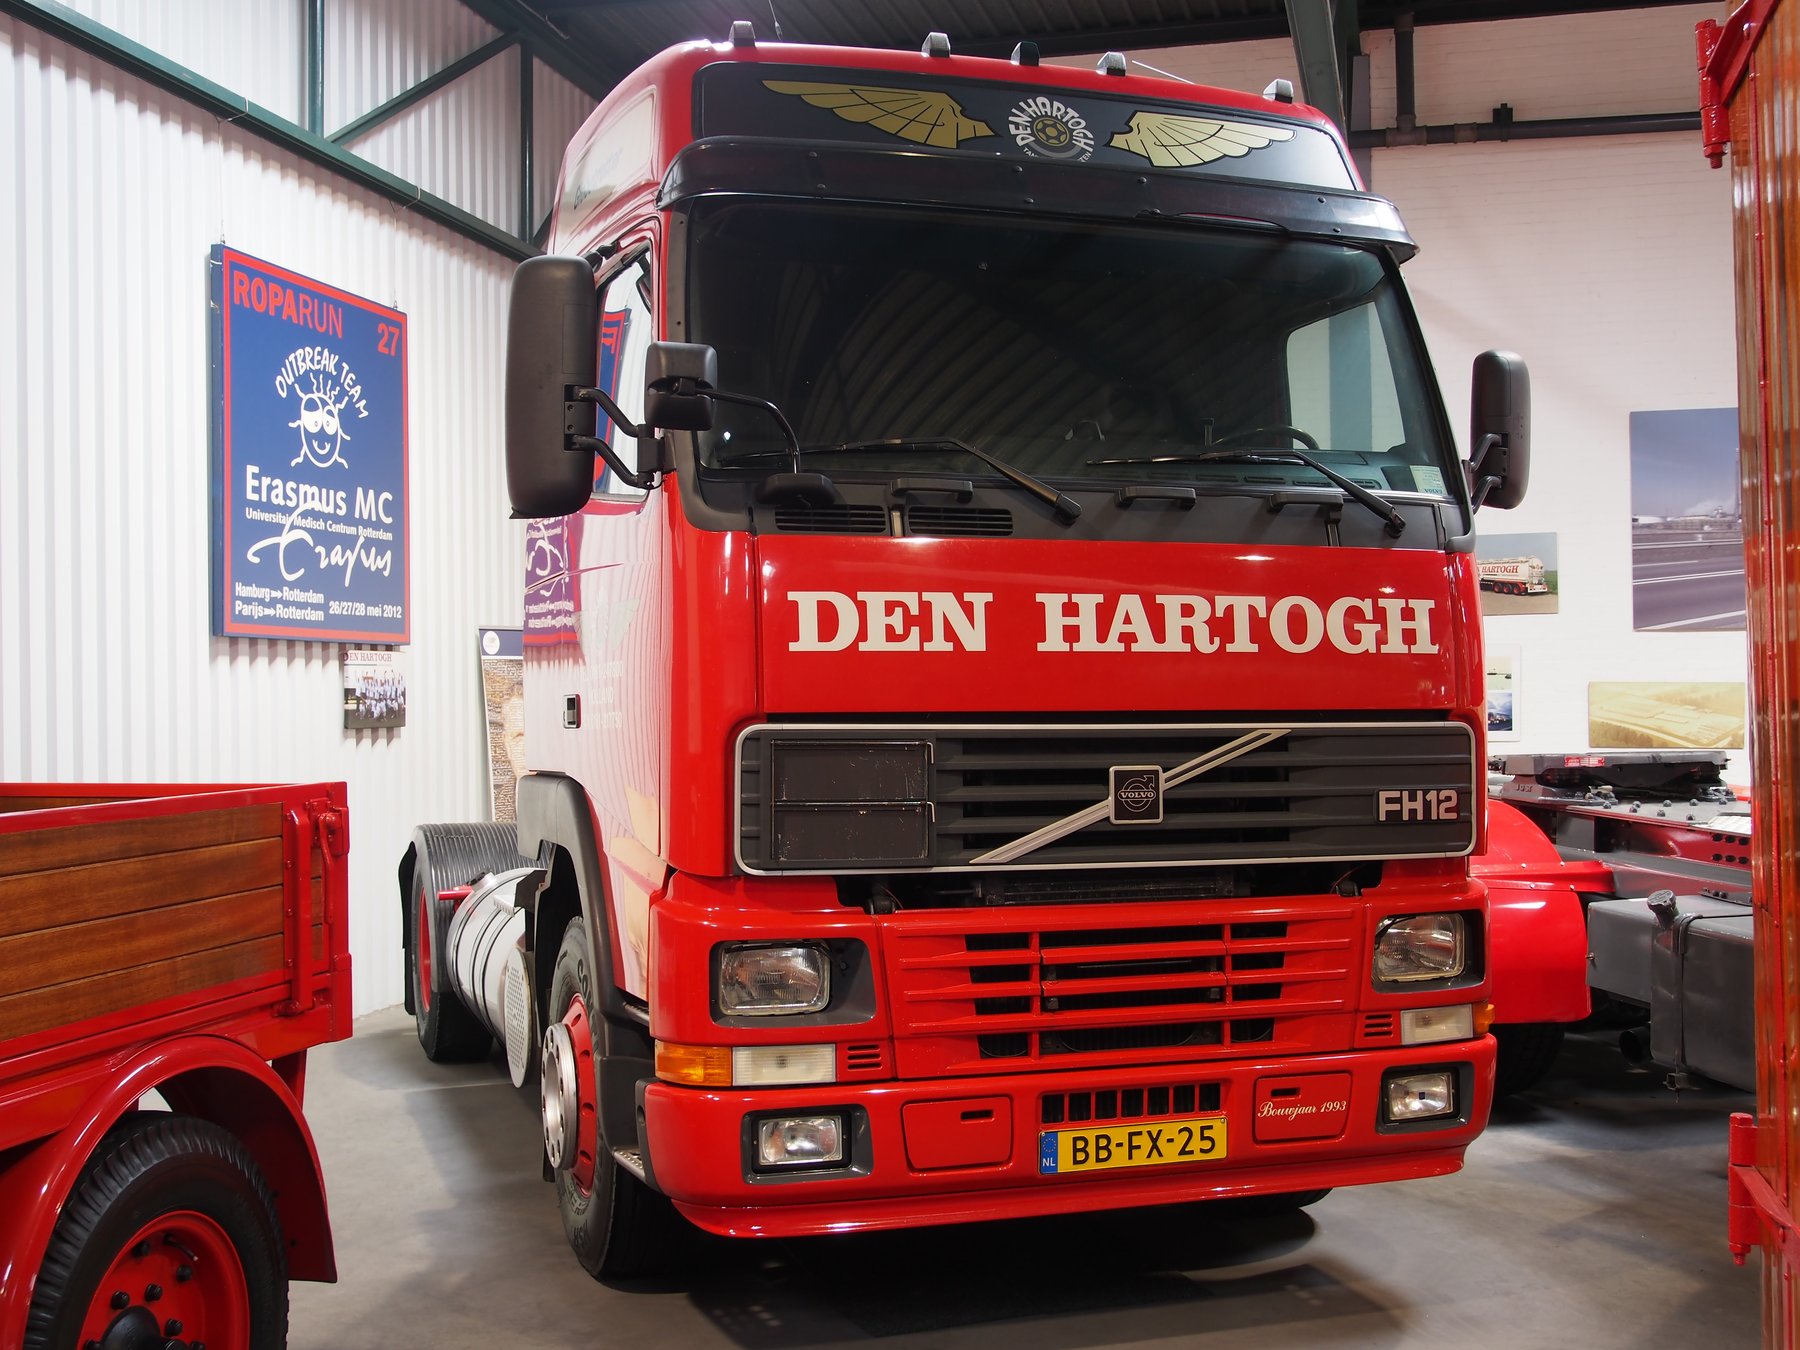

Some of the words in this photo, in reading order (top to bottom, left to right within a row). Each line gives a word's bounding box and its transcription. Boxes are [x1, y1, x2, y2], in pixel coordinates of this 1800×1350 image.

[1008, 108, 1036, 146] DEN
[1019, 96, 1095, 152] HARTOGH
[233, 270, 342, 339] ROPARUN
[377, 323, 400, 357] 27
[275, 346, 339, 398] OUTBREAK
[341, 362, 369, 418] TEAM
[246, 464, 347, 516] Erasmus
[354, 486, 393, 524] MC
[293, 515, 325, 531] Medisch
[326, 520, 356, 535] Centrum
[358, 526, 393, 540] Rotterdam
[1481, 564, 1519, 574] HARTOGH
[235, 582, 271, 602] Hamburg
[283, 586, 324, 604] Rotterdam
[235, 600, 264, 619] Parijs
[276, 604, 324, 621] Rotterdam
[329, 601, 365, 616] 26/27/28
[367, 605, 382, 617] mei
[383, 605, 402, 618] 2012
[788, 591, 993, 652] DEN
[1035, 592, 1439, 654] HARTOGH
[343, 652, 359, 662] DEN
[360, 652, 393, 663] HARTOGH
[1120, 791, 1154, 799] VOLVO
[1379, 789, 1458, 821] FH12
[1257, 1101, 1317, 1121] Bouwjaar
[1320, 1100, 1347, 1113] 1993
[1042, 1157, 1056, 1167] NL
[1072, 1125, 1216, 1166] BB-FX-25
